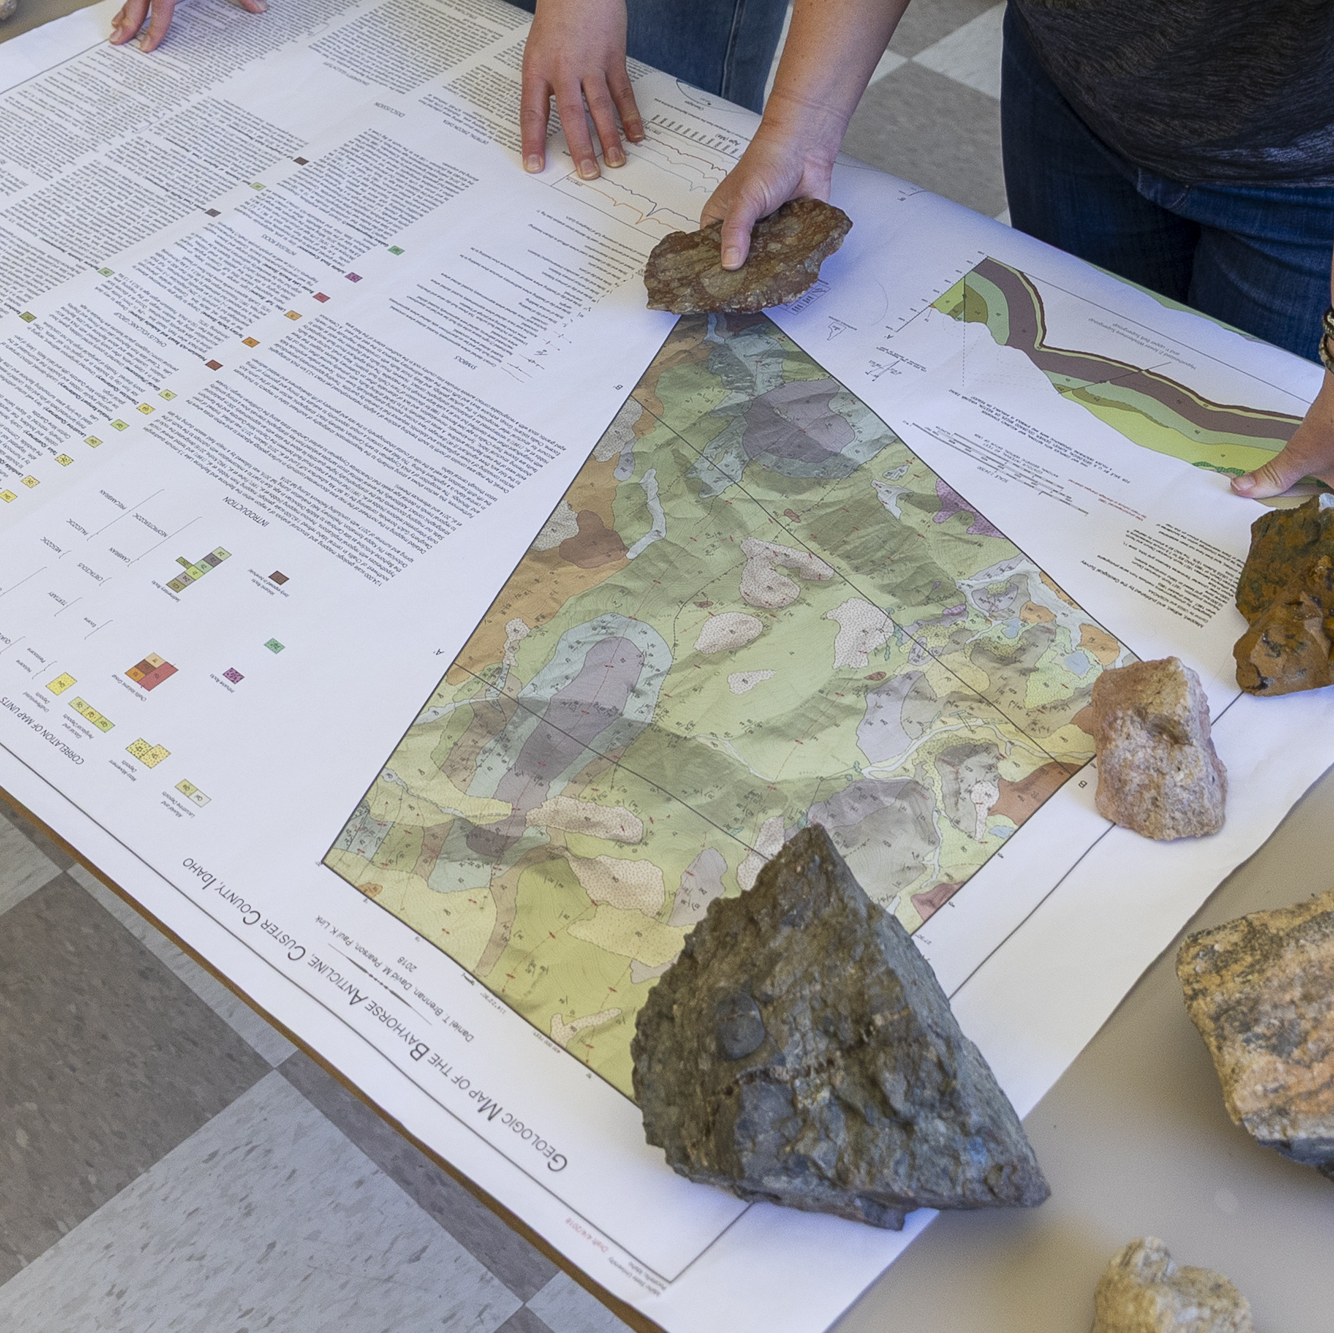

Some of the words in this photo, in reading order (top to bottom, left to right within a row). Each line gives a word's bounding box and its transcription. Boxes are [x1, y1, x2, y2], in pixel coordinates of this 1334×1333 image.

[98, 488, 127, 510] PRECAMBRIAN
[221, 495, 270, 527] INTRODUCTION
[65, 517, 89, 536] PALEOZOIC
[39, 535, 62, 553] MESOZOIC
[108, 546, 131, 563] CAMBRIAN
[76, 561, 104, 582] CRETACEOUS
[47, 591, 67, 606] TERTIARY
[15, 711, 35, 725] MAP
[29, 722, 44, 732] OF
[39, 728, 85, 765] CORRELATION
[1076, 778, 1088, 788] B
[181, 857, 217, 890] IDAHO
[213, 881, 261, 926] COUNTY,
[314, 914, 331, 929] Link
[328, 925, 339, 935] K.
[259, 918, 306, 961] CUSTER
[335, 931, 354, 947] Paul
[353, 941, 383, 968] Pearson,
[396, 955, 417, 973] 2018
[306, 953, 369, 1006] ANTICLINE,
[381, 965, 393, 976] M.
[389, 971, 413, 991] David
[412, 986, 444, 1017] Brennan,
[441, 1015, 450, 1024] T.
[363, 999, 430, 1062] BAYHORSE
[447, 1019, 474, 1043] Daniel
[426, 1052, 453, 1077] THE
[449, 1075, 471, 1090] OF
[467, 1089, 503, 1122] MAP
[500, 1112, 568, 1172] GEOLOGIC
